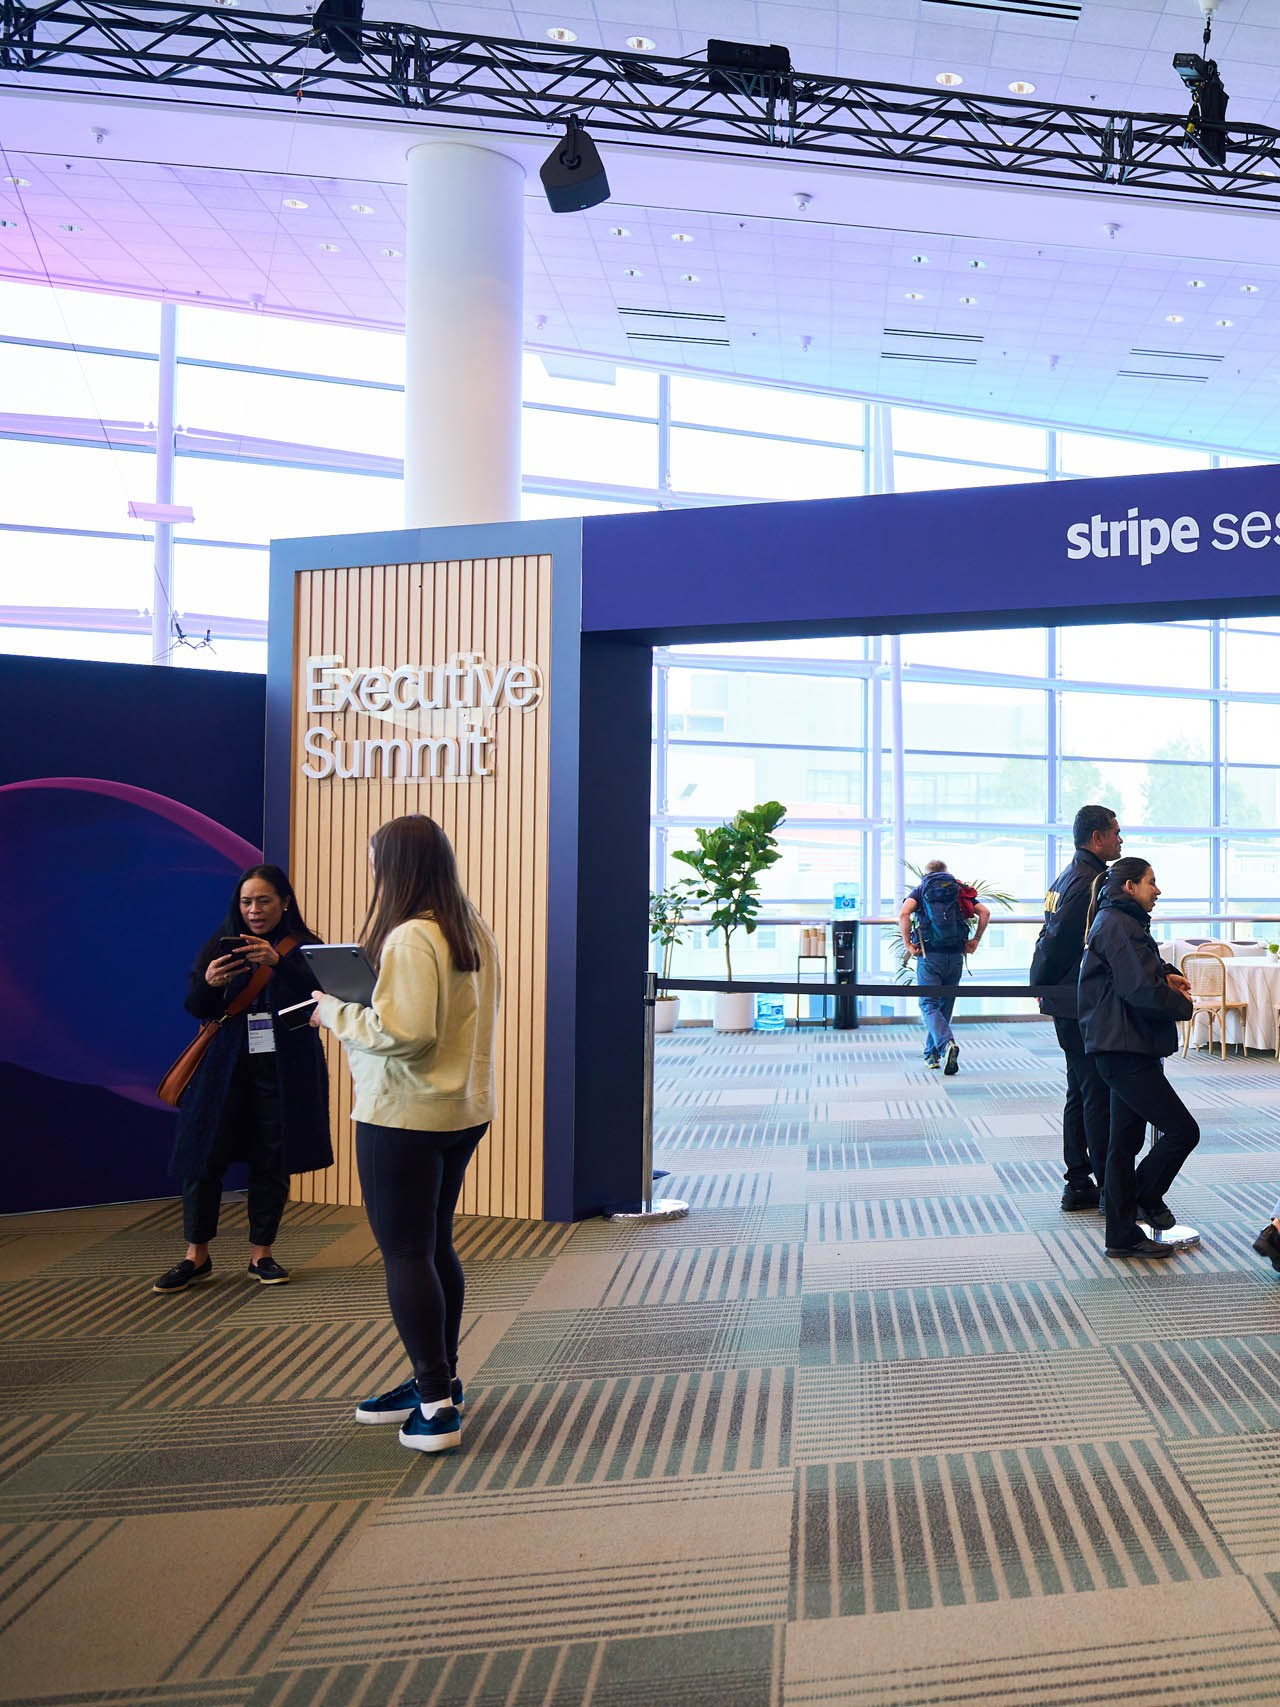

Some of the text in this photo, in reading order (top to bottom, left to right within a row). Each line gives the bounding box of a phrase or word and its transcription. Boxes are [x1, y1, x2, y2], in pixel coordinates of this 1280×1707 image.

[1066, 507, 1200, 566] stripe
[305, 654, 538, 713] Executive
[301, 723, 494, 779] Summit
